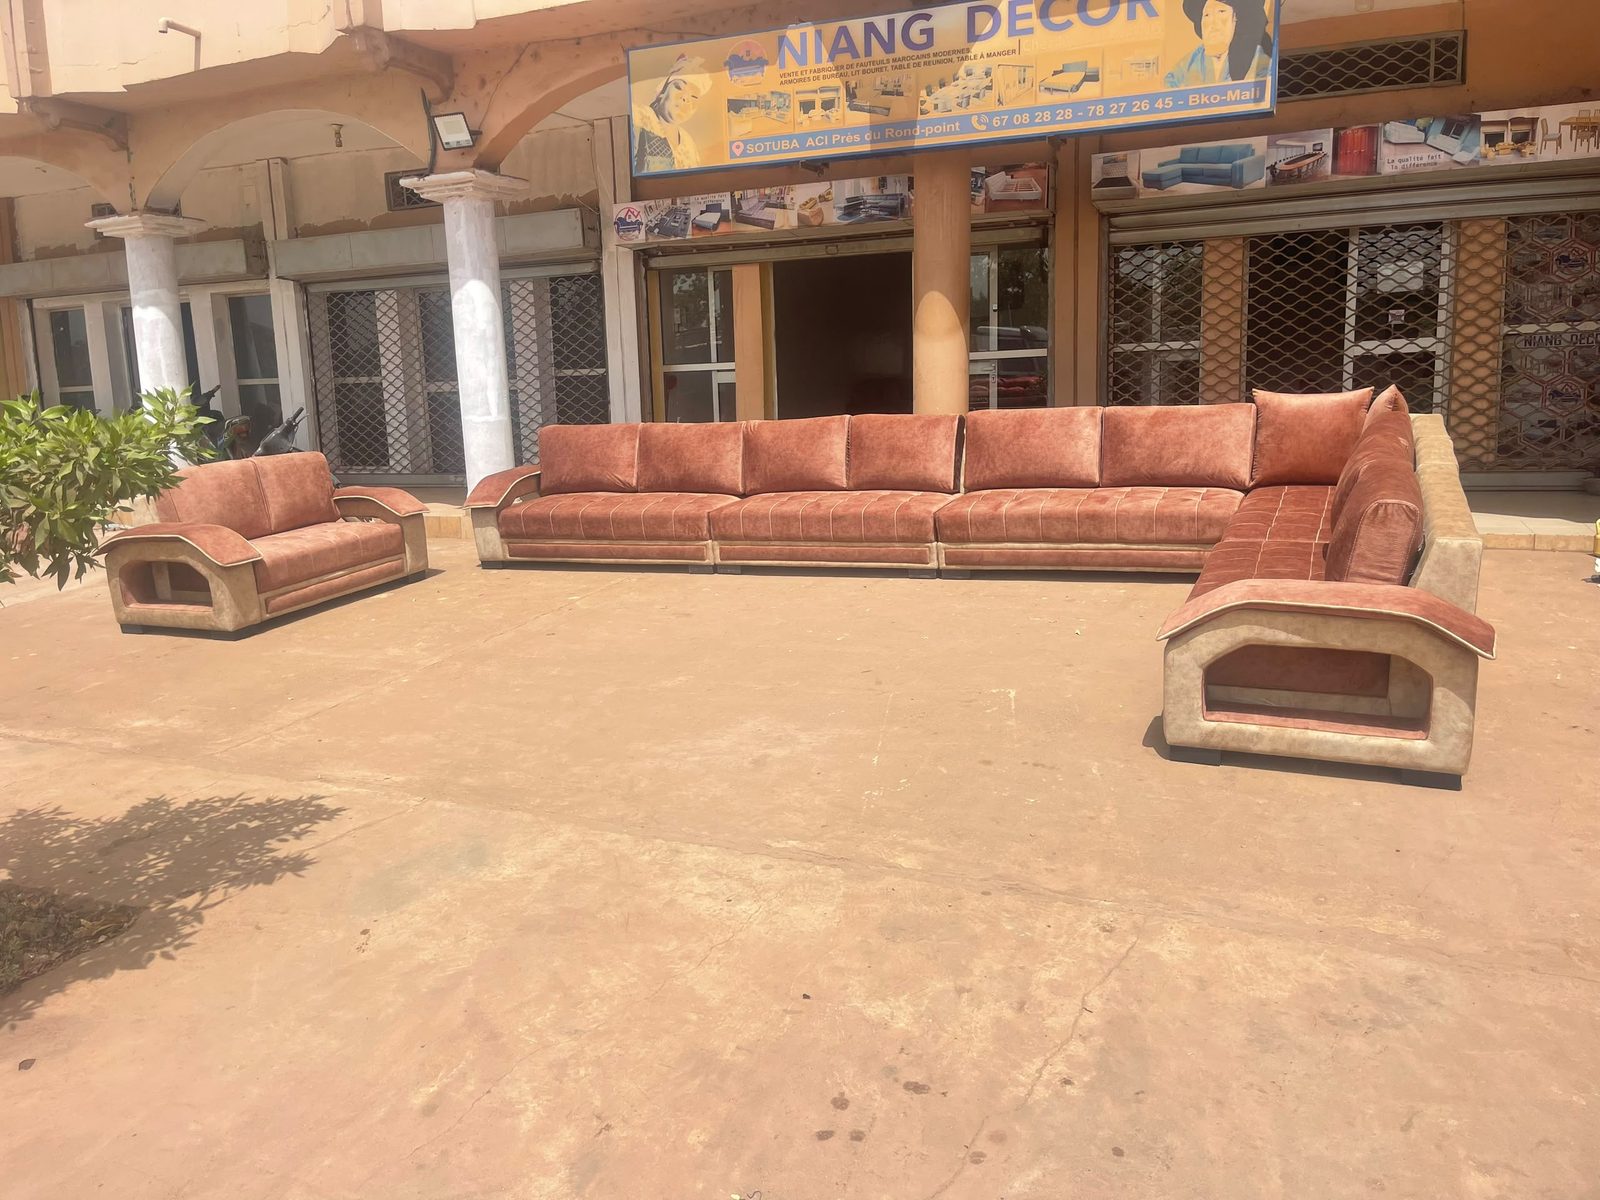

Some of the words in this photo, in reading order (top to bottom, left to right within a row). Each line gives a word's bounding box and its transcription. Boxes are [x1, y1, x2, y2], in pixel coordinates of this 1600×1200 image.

[778, 13, 935, 70] NIANG
[779, 70, 799, 79] VENTE
[809, 64, 844, 75] FABRIQUER
[845, 62, 854, 70] DE
[855, 57, 890, 68] FAUTEUILS
[892, 53, 931, 64] MAROCAINS
[779, 76, 811, 86] ARMOIRES
[851, 69, 860, 77] LIT
[891, 61, 911, 70] TABLE
[913, 60, 921, 69] DE
[957, 54, 977, 63] TABLE
[986, 49, 1017, 59] MANGER
[746, 138, 800, 154] SOTUBA
[805, 135, 828, 148] ACI
[864, 129, 881, 142] du
[885, 121, 960, 139] Rond-point
[992, 115, 1009, 128] 67
[1013, 113, 1030, 125] 08
[1034, 110, 1051, 123] 28
[1055, 108, 1073, 120] 28
[1087, 104, 1105, 117] 78
[1109, 102, 1127, 114] 27
[1131, 99, 1150, 112] 26
[1154, 96, 1173, 109] 45
[1188, 87, 1260, 106] Bko-Mali
[1524, 335, 1562, 347] NIANG
